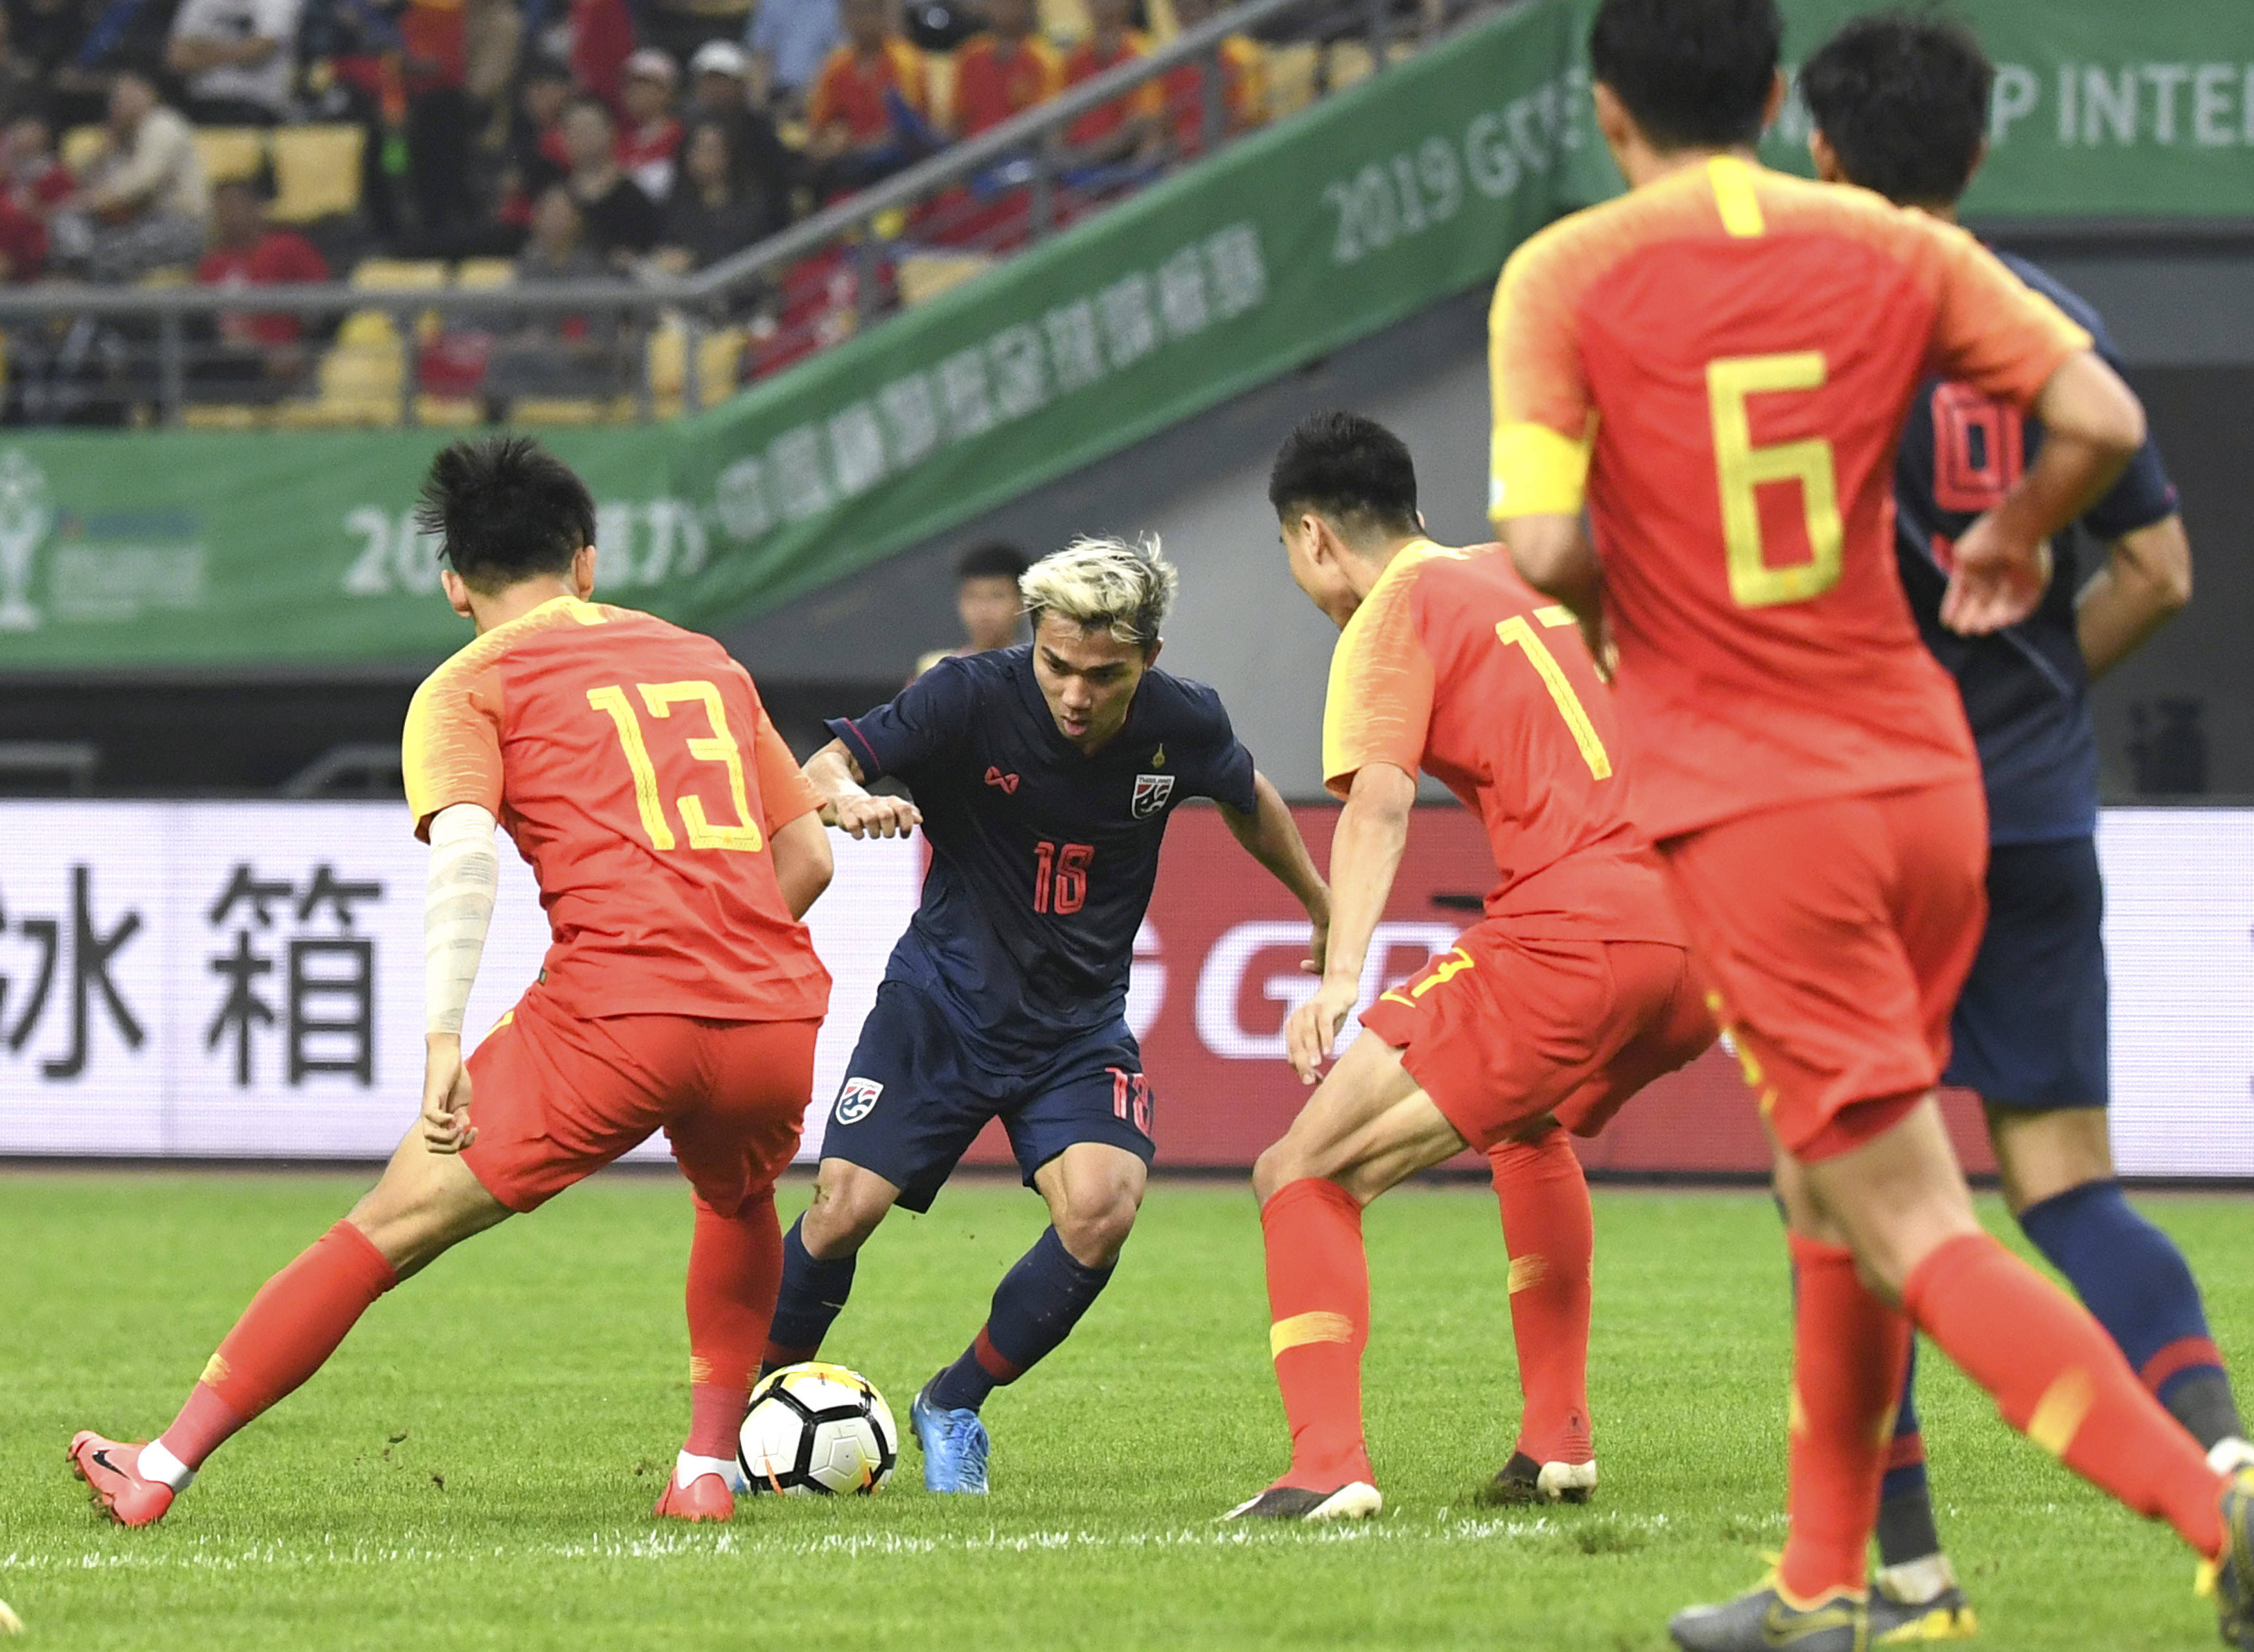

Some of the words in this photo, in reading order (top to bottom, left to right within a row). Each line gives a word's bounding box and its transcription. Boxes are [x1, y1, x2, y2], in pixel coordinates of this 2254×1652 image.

[2057, 61, 2254, 146] INTE
[1706, 350, 1842, 608] 6
[587, 680, 763, 852] 13
[1495, 604, 1612, 781] 1
[0, 863, 384, 1087] 冰箱
